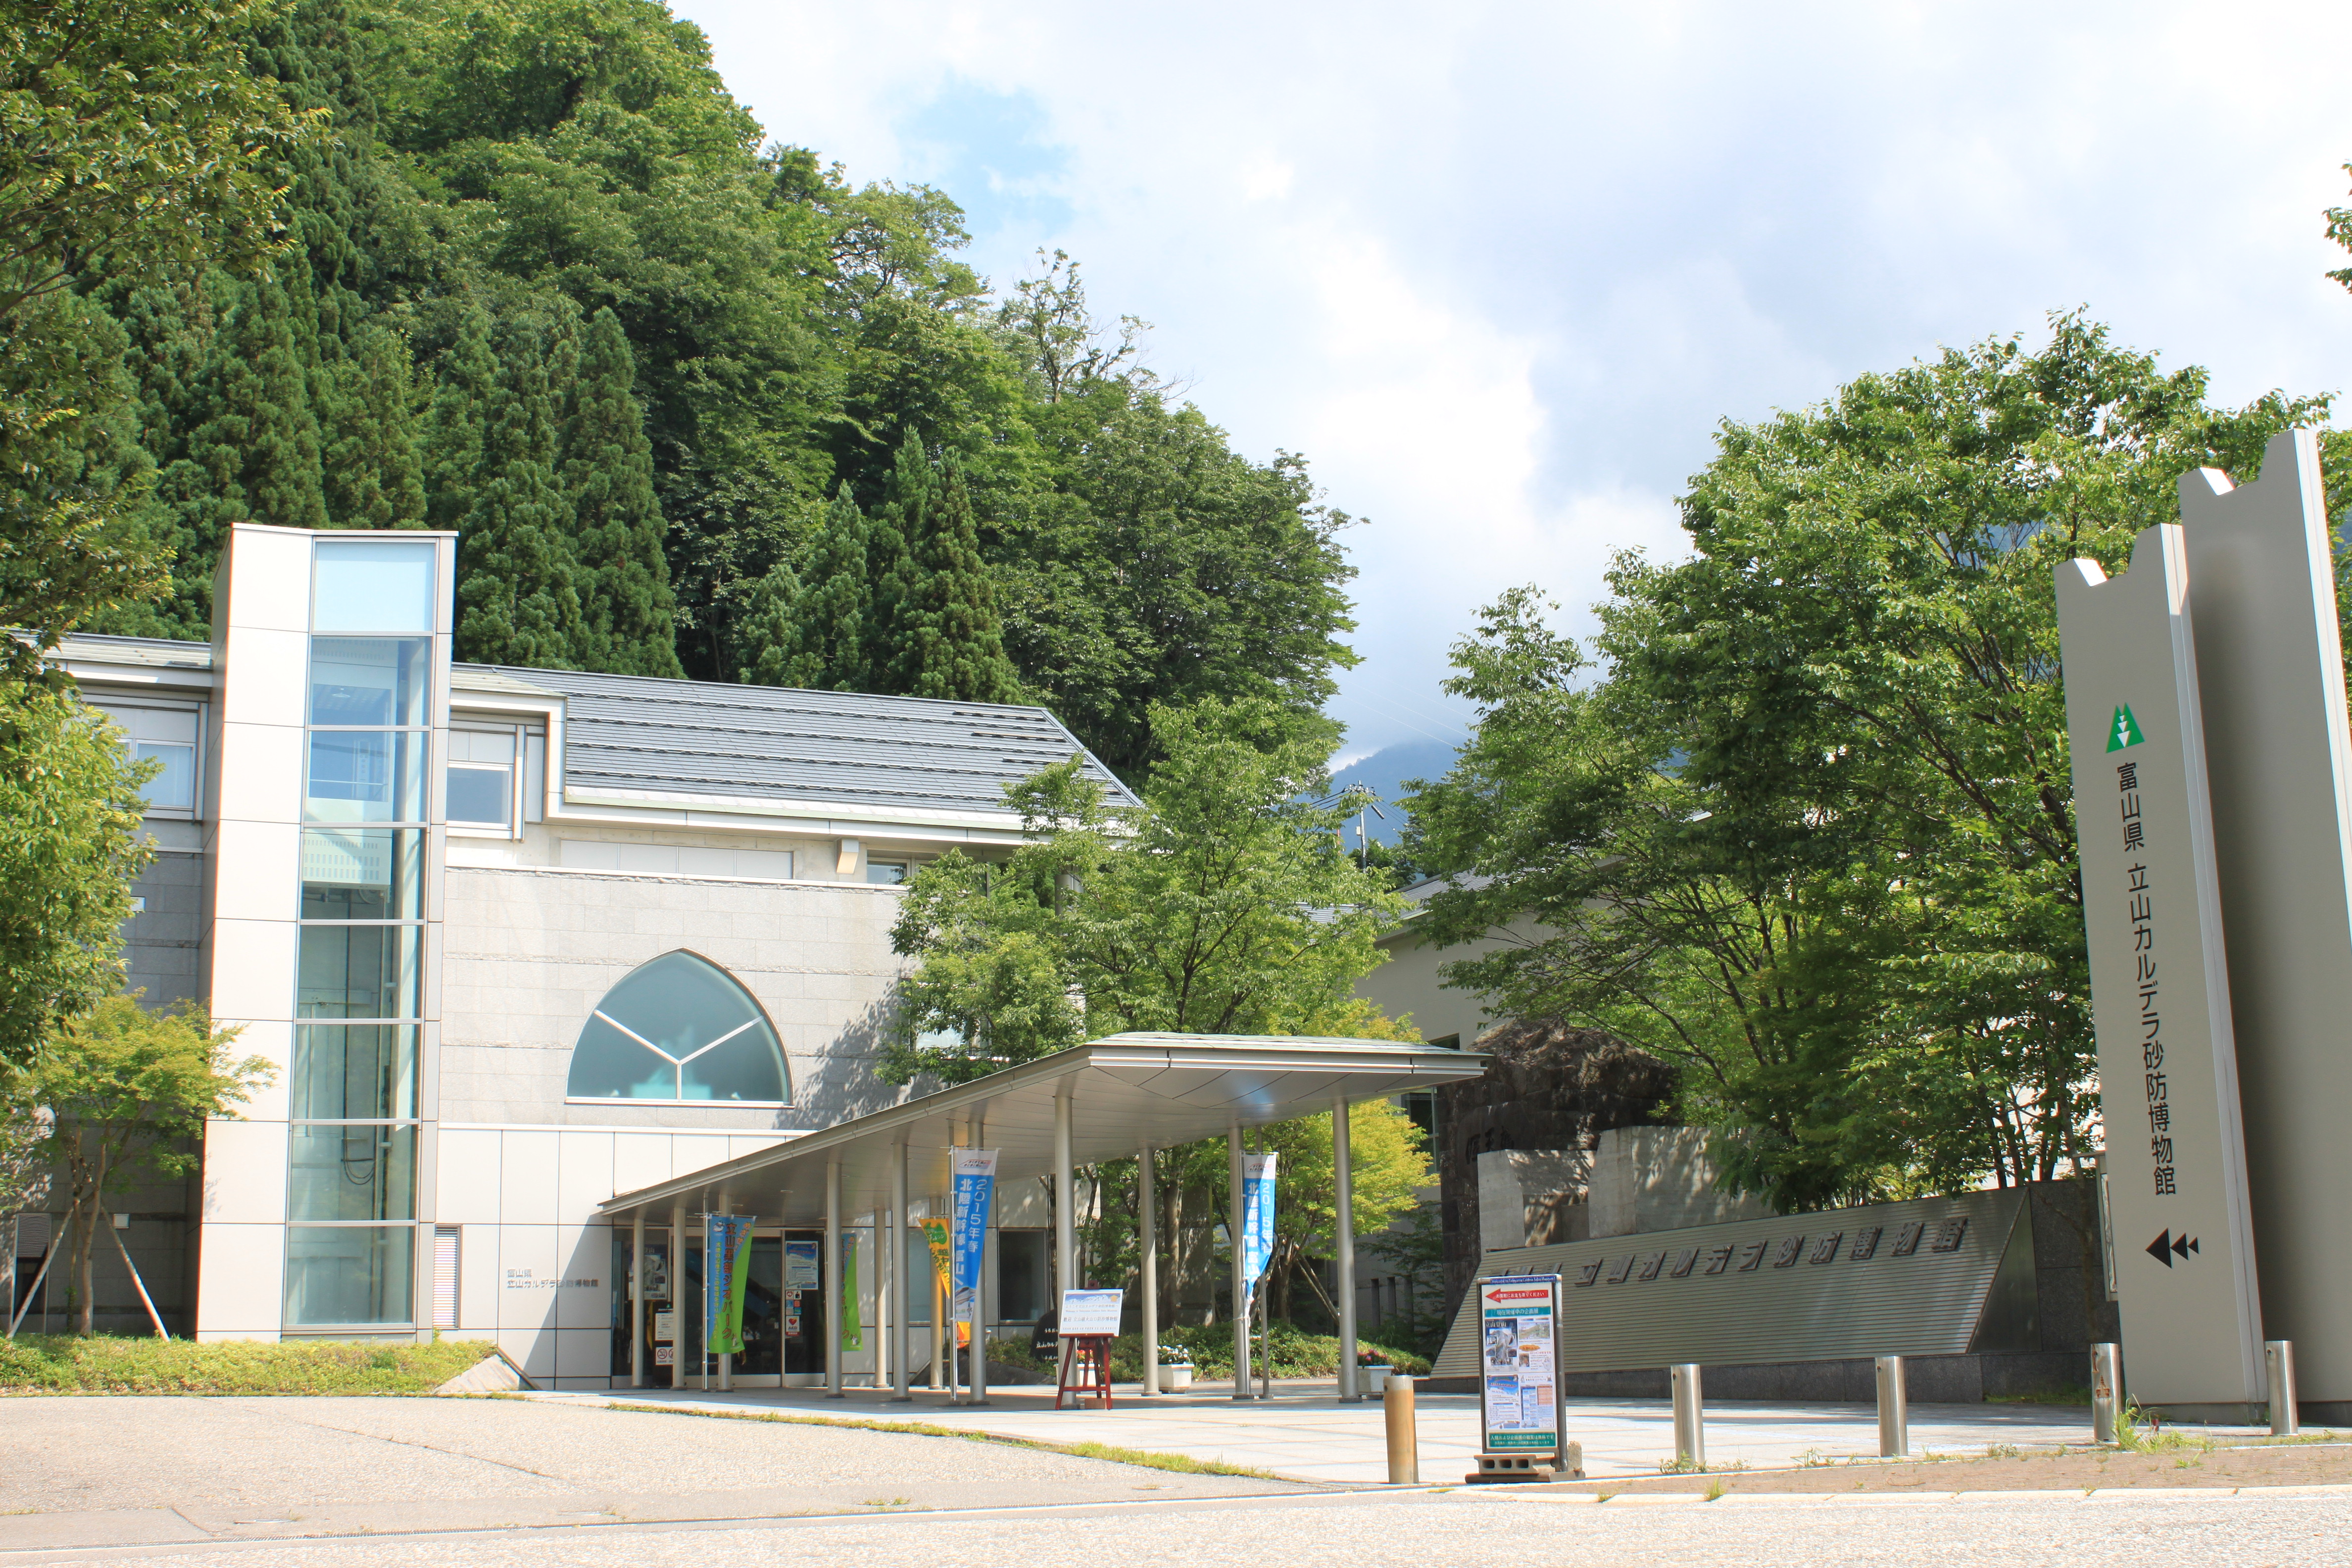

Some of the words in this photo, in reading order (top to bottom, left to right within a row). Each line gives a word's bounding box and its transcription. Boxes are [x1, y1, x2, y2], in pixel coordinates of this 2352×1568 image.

[2117, 762, 2145, 852] 富山県
[2127, 863, 2176, 1196] 立山カルデラ砂防博物館
[967, 1179, 987, 1253] 2015年春
[1262, 1182, 1273, 1253] 2015年春
[1575, 1218, 1967, 1286] 立山カルデラ砂防博物館
[507, 1269, 532, 1278] 富山県
[507, 1279, 598, 1288] 立山カルデラ砂防博物館
[722, 1223, 737, 1339] 立山黒部ジオパーク
